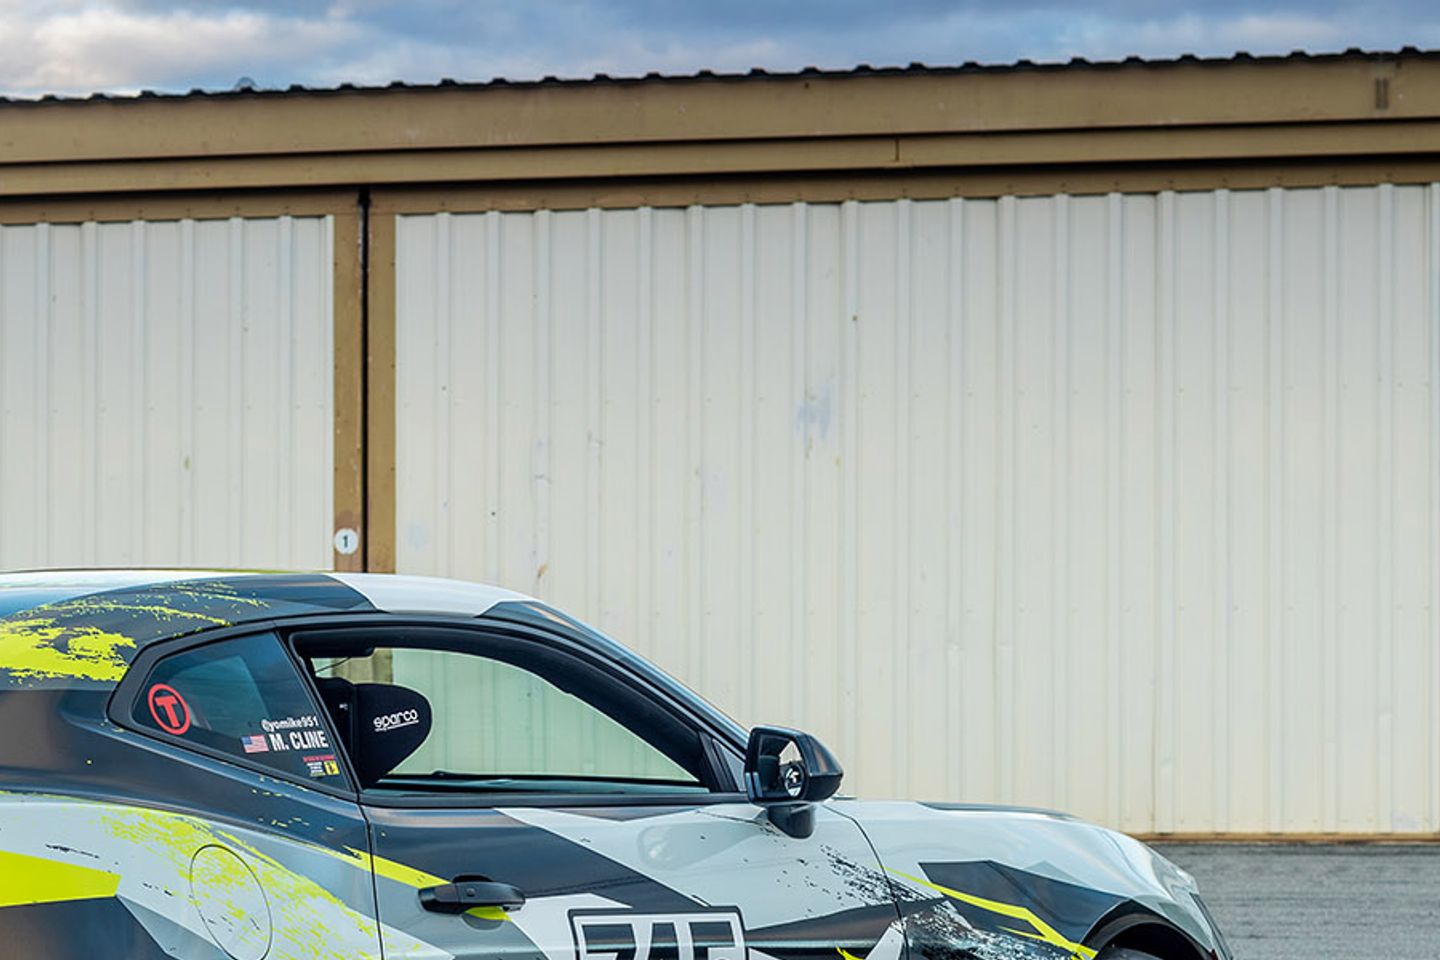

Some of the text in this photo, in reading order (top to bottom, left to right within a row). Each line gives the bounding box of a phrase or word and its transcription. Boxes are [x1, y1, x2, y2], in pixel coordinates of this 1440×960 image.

[373, 709, 418, 731] sparco
[268, 730, 329, 751] M. CLINE
